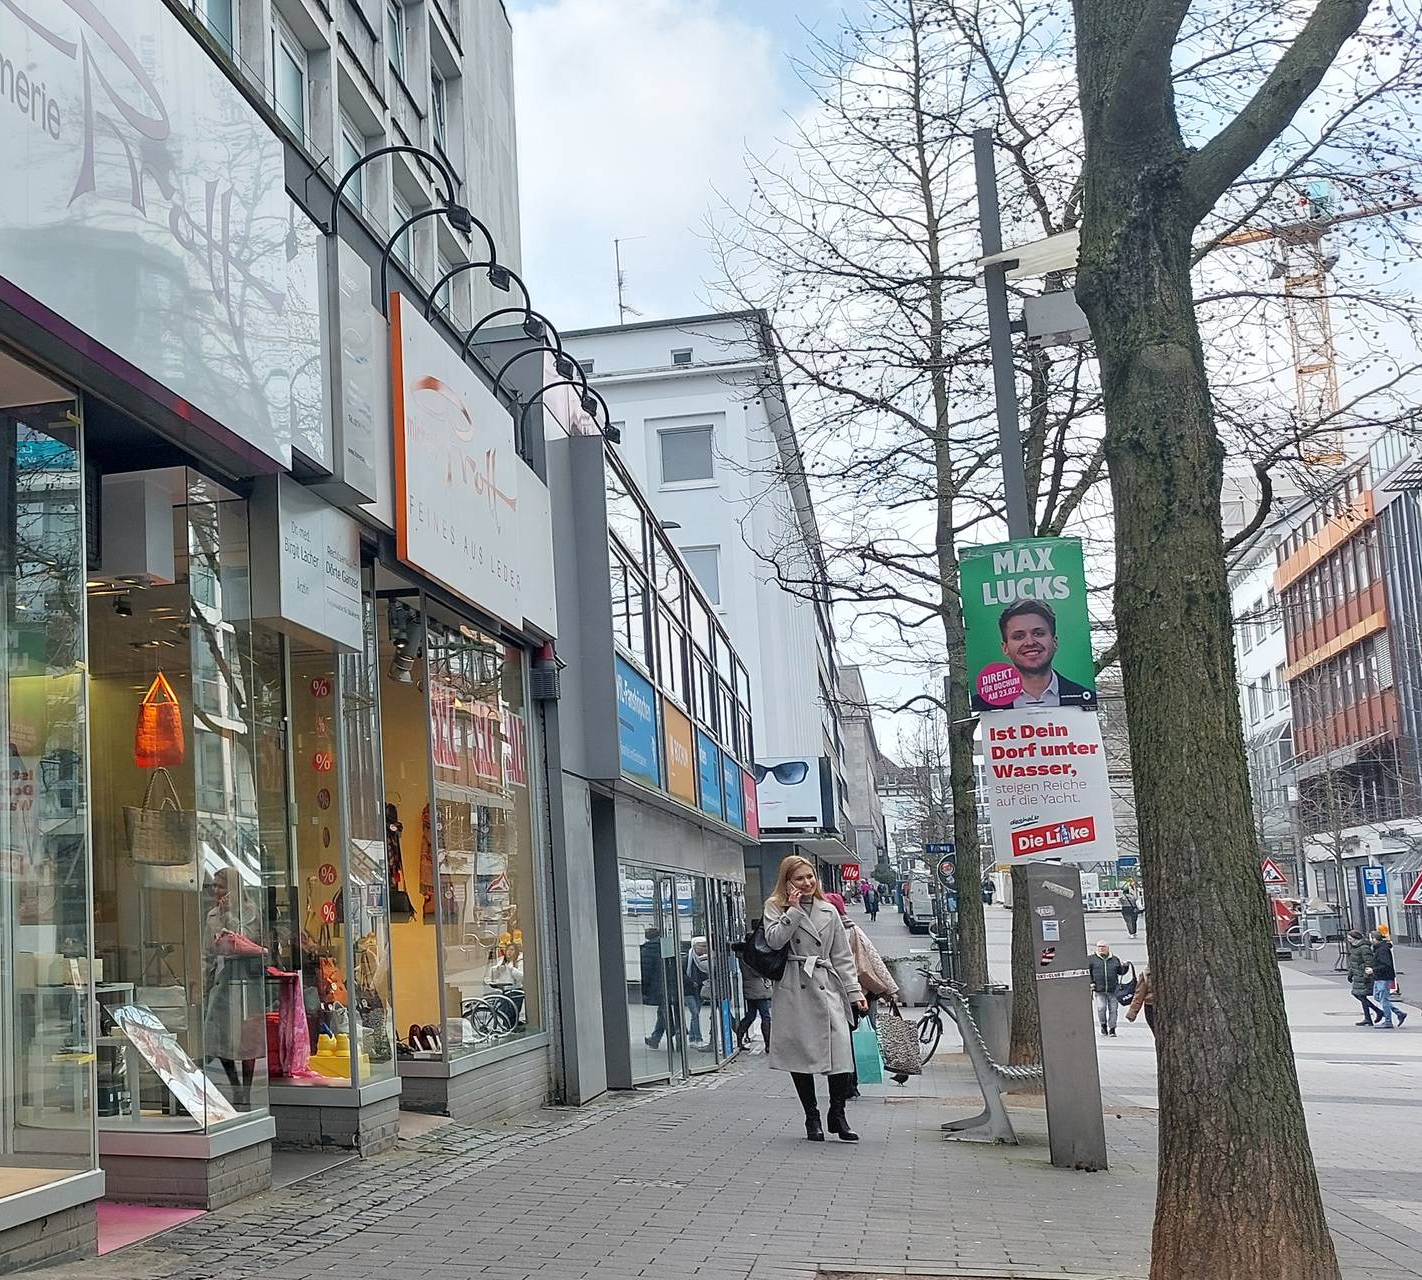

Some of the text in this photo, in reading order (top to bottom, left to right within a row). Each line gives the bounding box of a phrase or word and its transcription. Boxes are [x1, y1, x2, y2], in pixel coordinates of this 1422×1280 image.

[409, 494, 522, 592] FEINES AUS LEDER
[993, 547, 1055, 576] MAX
[982, 575, 1071, 606] LUCKS
[982, 668, 1013, 685] DIREKT
[981, 677, 1020, 694] FÜR BOCHUM
[988, 692, 999, 702] AM
[989, 723, 1068, 741] Ist Dein
[991, 741, 1099, 760] Dorf unter
[993, 763, 1077, 779] Wasser,
[995, 780, 1087, 795] steigen Reiche
[997, 793, 1081, 807] auf die Yacht.
[1018, 825, 1090, 851] Die Like
[843, 867, 859, 879] illy
